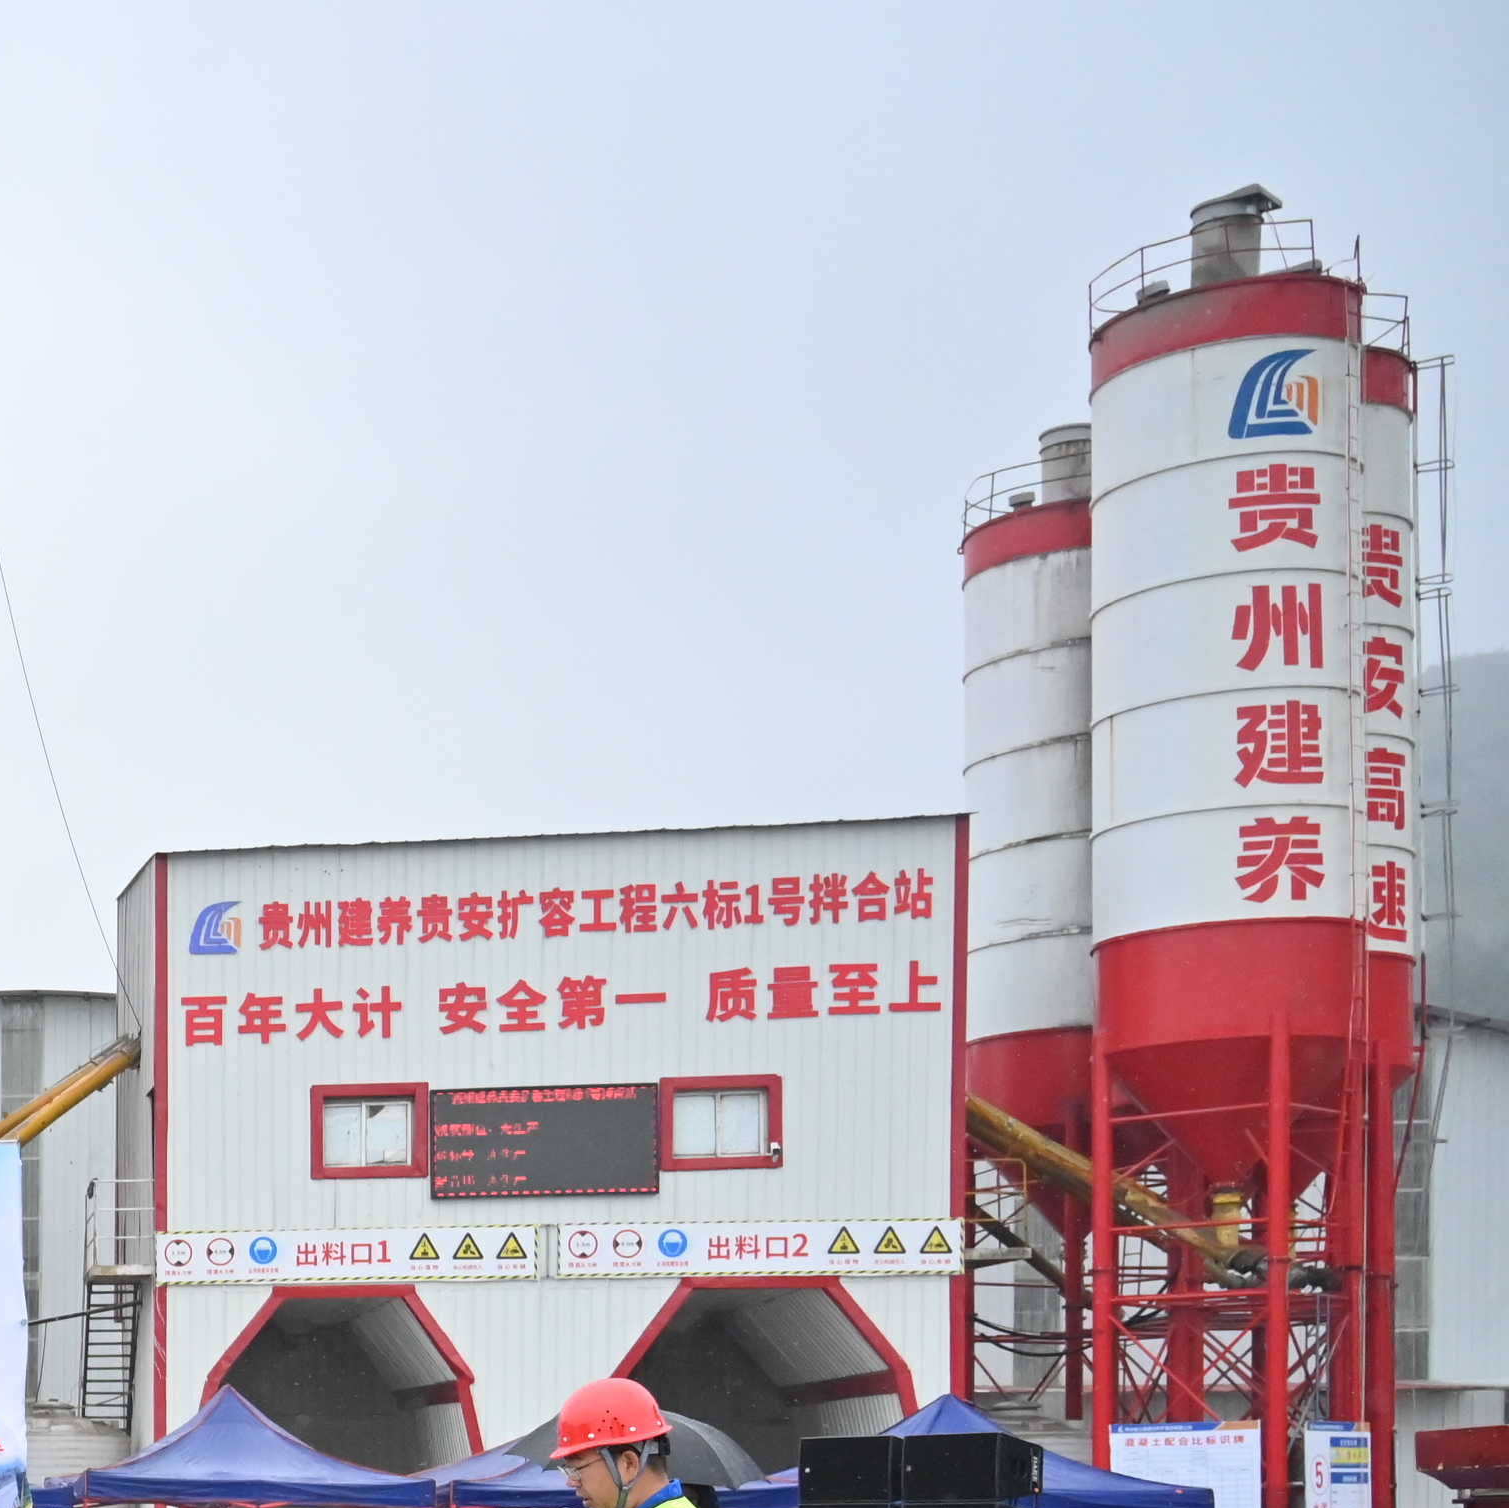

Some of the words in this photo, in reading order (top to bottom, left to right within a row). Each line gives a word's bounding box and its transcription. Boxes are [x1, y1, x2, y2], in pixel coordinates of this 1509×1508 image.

[1228, 463, 1325, 903] 贵州建养
[1361, 522, 1409, 943] 贵安高速
[258, 868, 934, 950] 贵州建养贵安扩容工程六标1号拌合站
[180, 985, 403, 1047] 百年大计
[438, 975, 667, 1035] 安全第一
[706, 960, 942, 1022] 质量至上
[295, 1240, 392, 1267] 出料口1
[707, 1233, 810, 1261] 出料口2
[1315, 1462, 1324, 1488] 5
